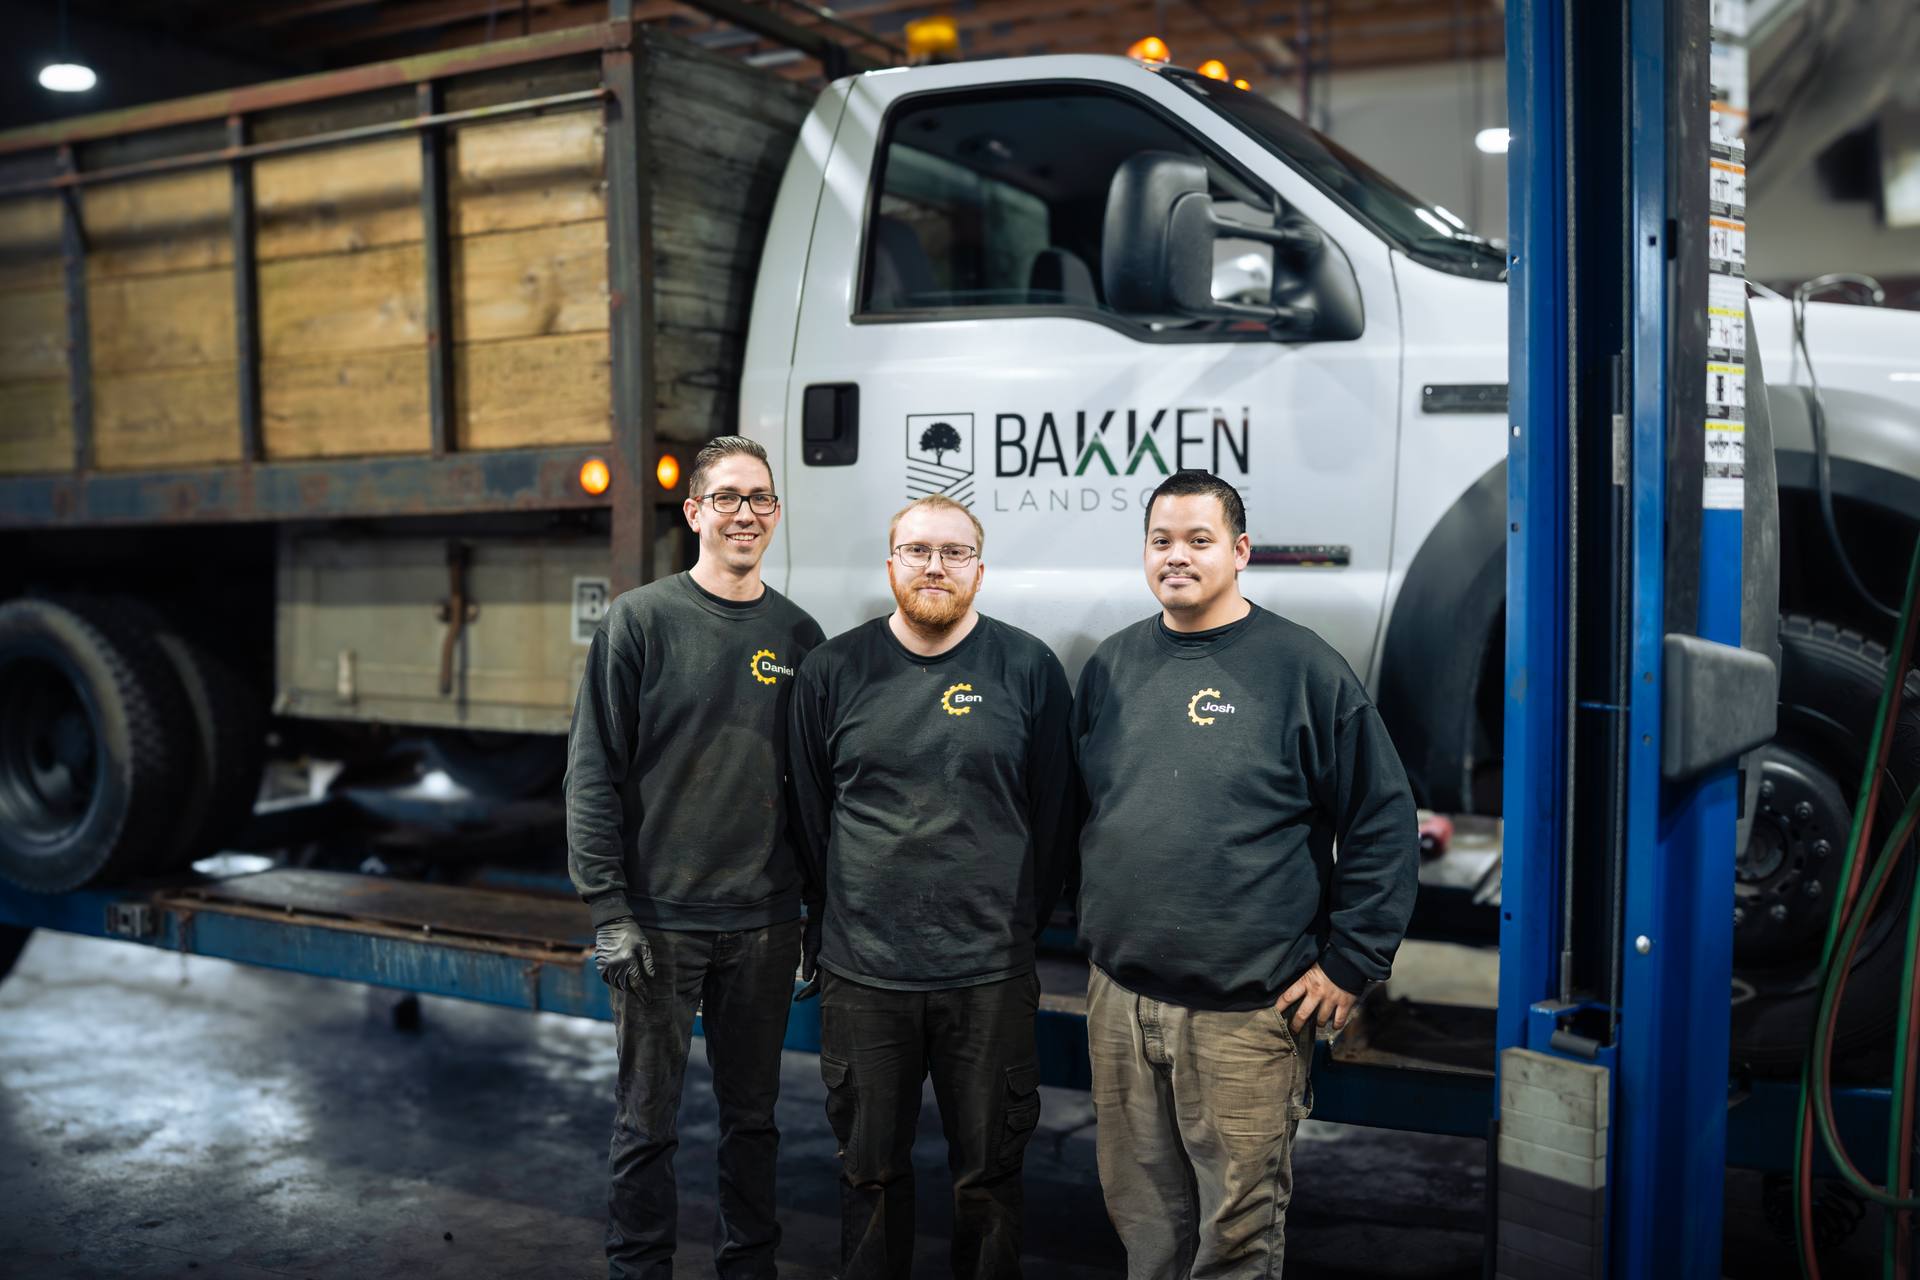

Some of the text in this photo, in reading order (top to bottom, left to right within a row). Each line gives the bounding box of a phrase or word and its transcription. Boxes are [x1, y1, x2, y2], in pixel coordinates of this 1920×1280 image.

[995, 407, 1249, 477] BAKKEN
[762, 661, 794, 676] Daniel
[955, 694, 982, 702] Ben
[1201, 702, 1235, 713] Josh
